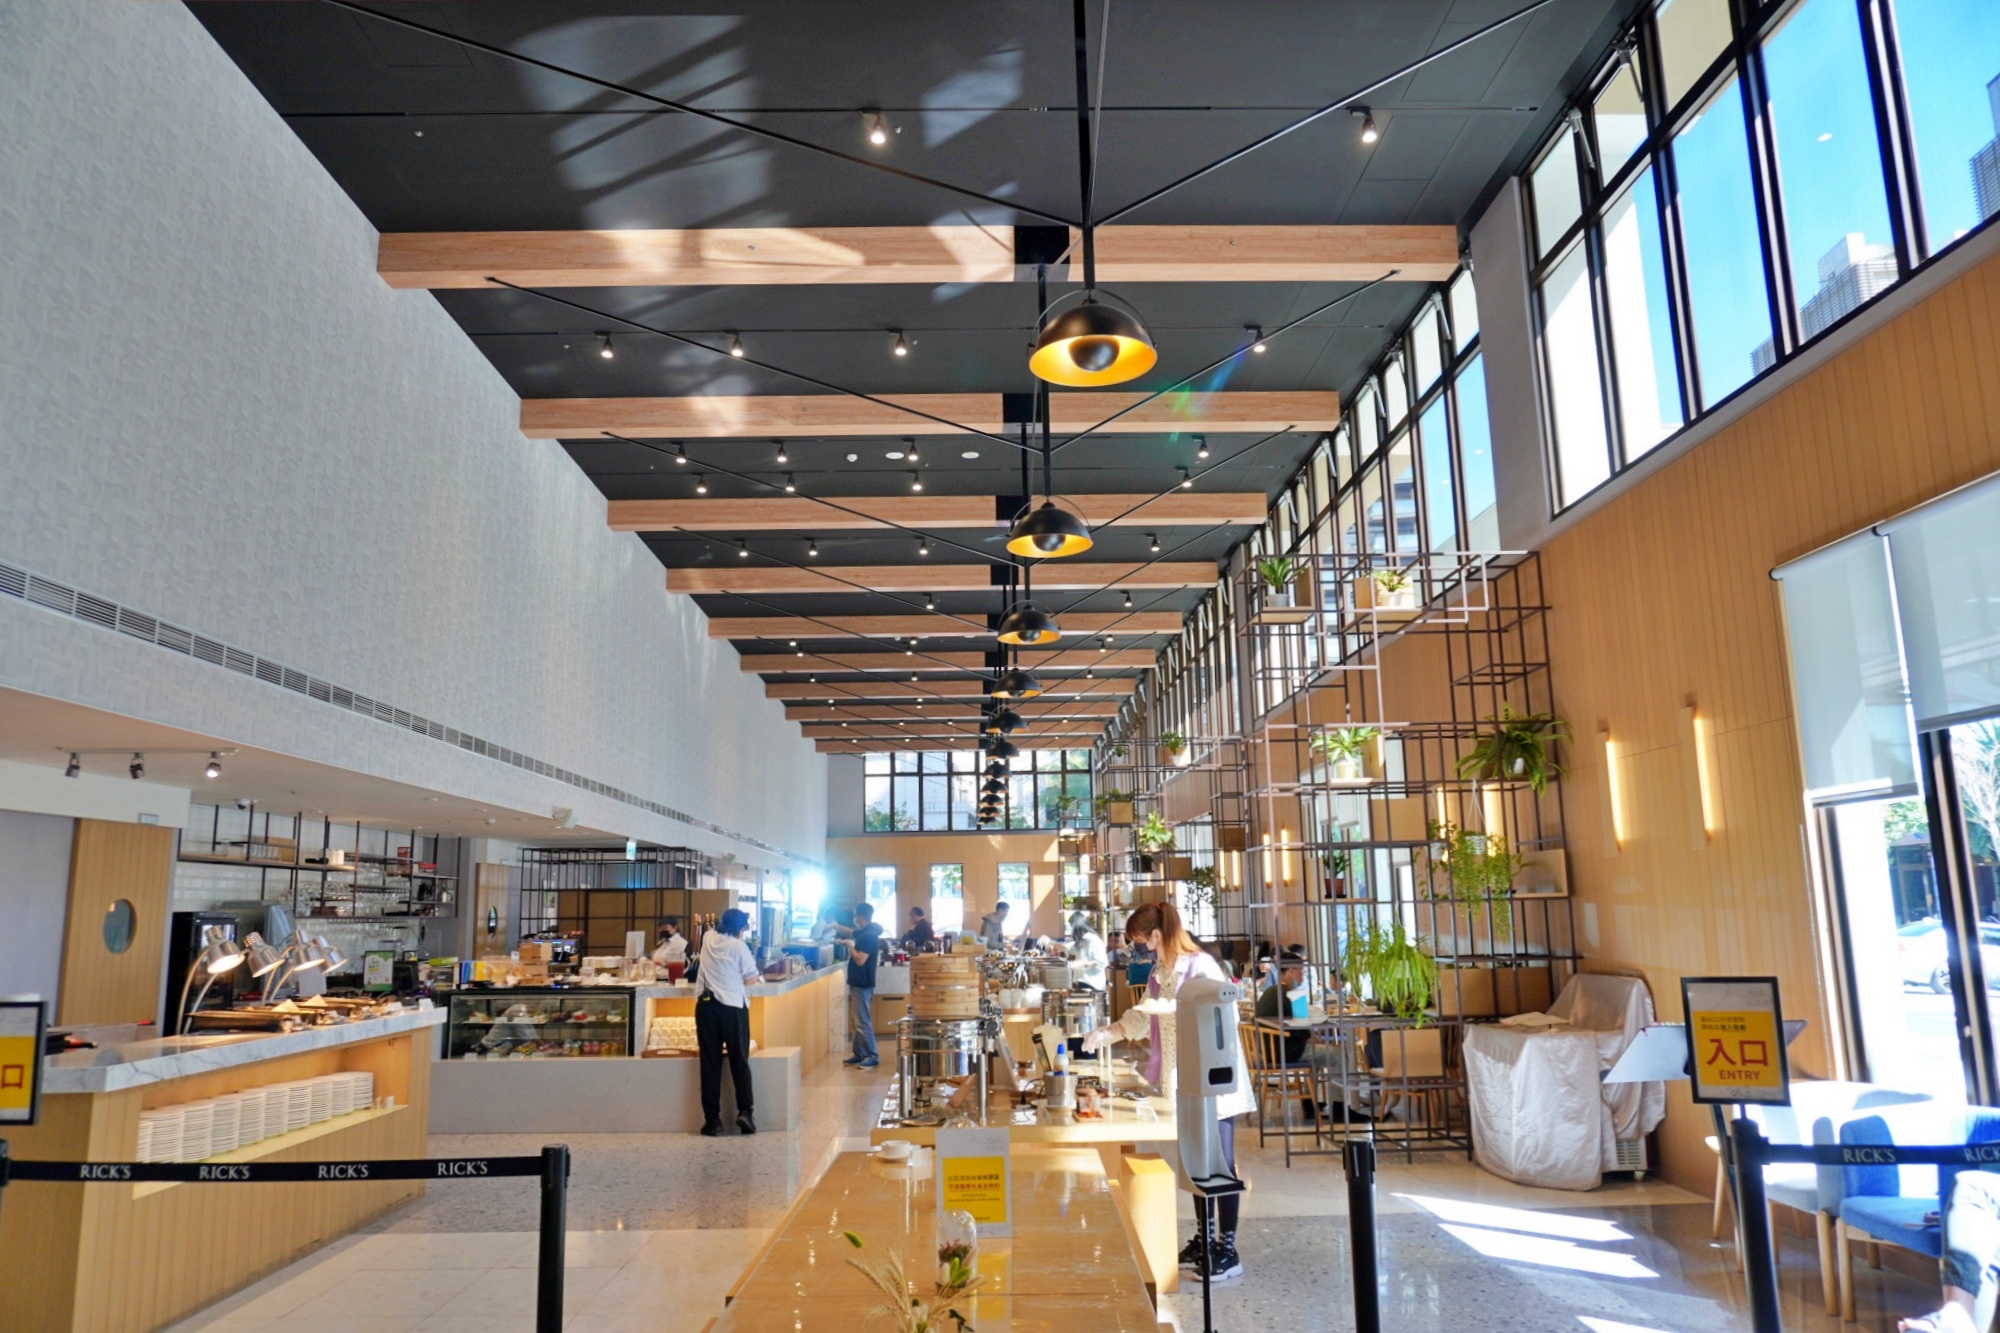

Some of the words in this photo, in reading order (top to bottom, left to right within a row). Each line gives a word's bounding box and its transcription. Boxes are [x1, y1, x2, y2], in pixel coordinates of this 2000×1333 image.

[1707, 1038, 1768, 1066] 入口
[1719, 1069, 1760, 1080] ENTRY
[1842, 1148, 1896, 1163] RICK'S
[80, 1164, 131, 1178] RICK'S
[199, 1164, 250, 1179] RICK'S
[318, 1164, 369, 1179] RICK'S
[437, 1161, 488, 1176] RICK'S
